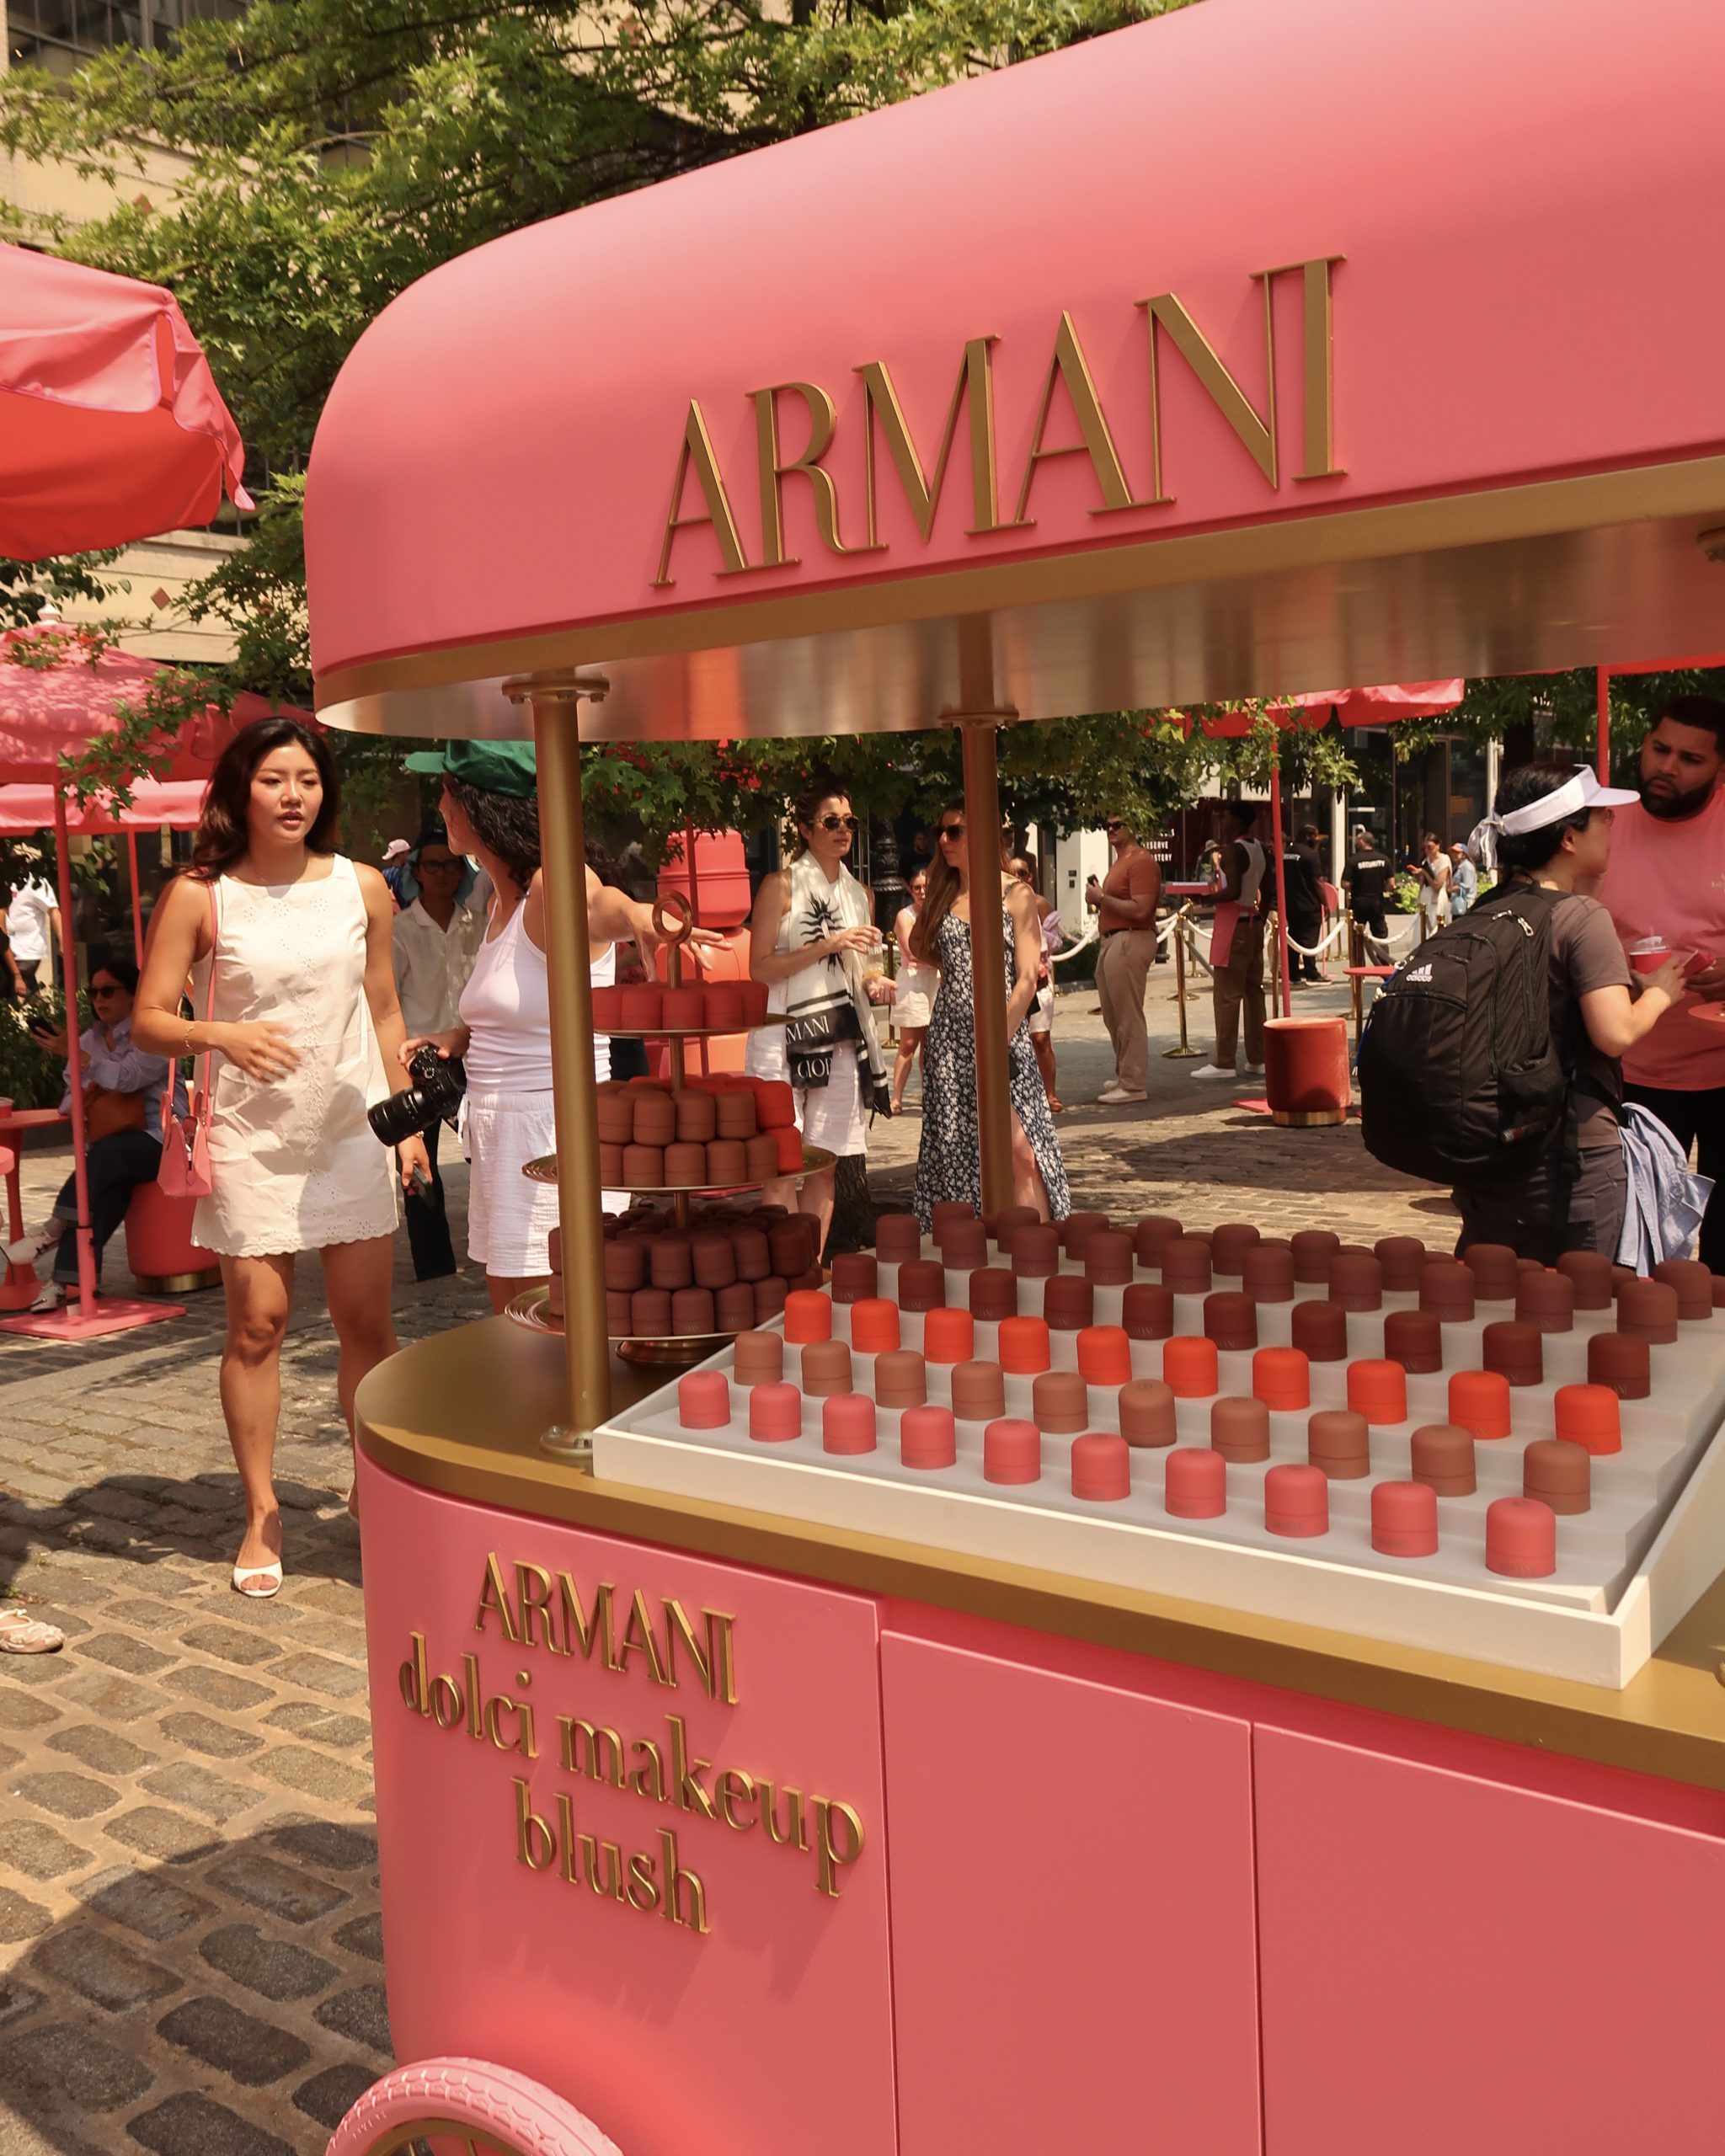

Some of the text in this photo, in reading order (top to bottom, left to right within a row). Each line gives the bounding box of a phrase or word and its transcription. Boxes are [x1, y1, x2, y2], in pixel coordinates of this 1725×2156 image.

[649, 254, 1347, 586] ARMANI
[1152, 853, 1172, 862] STERY
[786, 1015, 830, 1045] MANI
[1406, 974, 1433, 982] adidas
[473, 1552, 739, 1705] ARMANI
[398, 1630, 864, 1897] dolci makeup
[510, 1776, 711, 1934] blush
